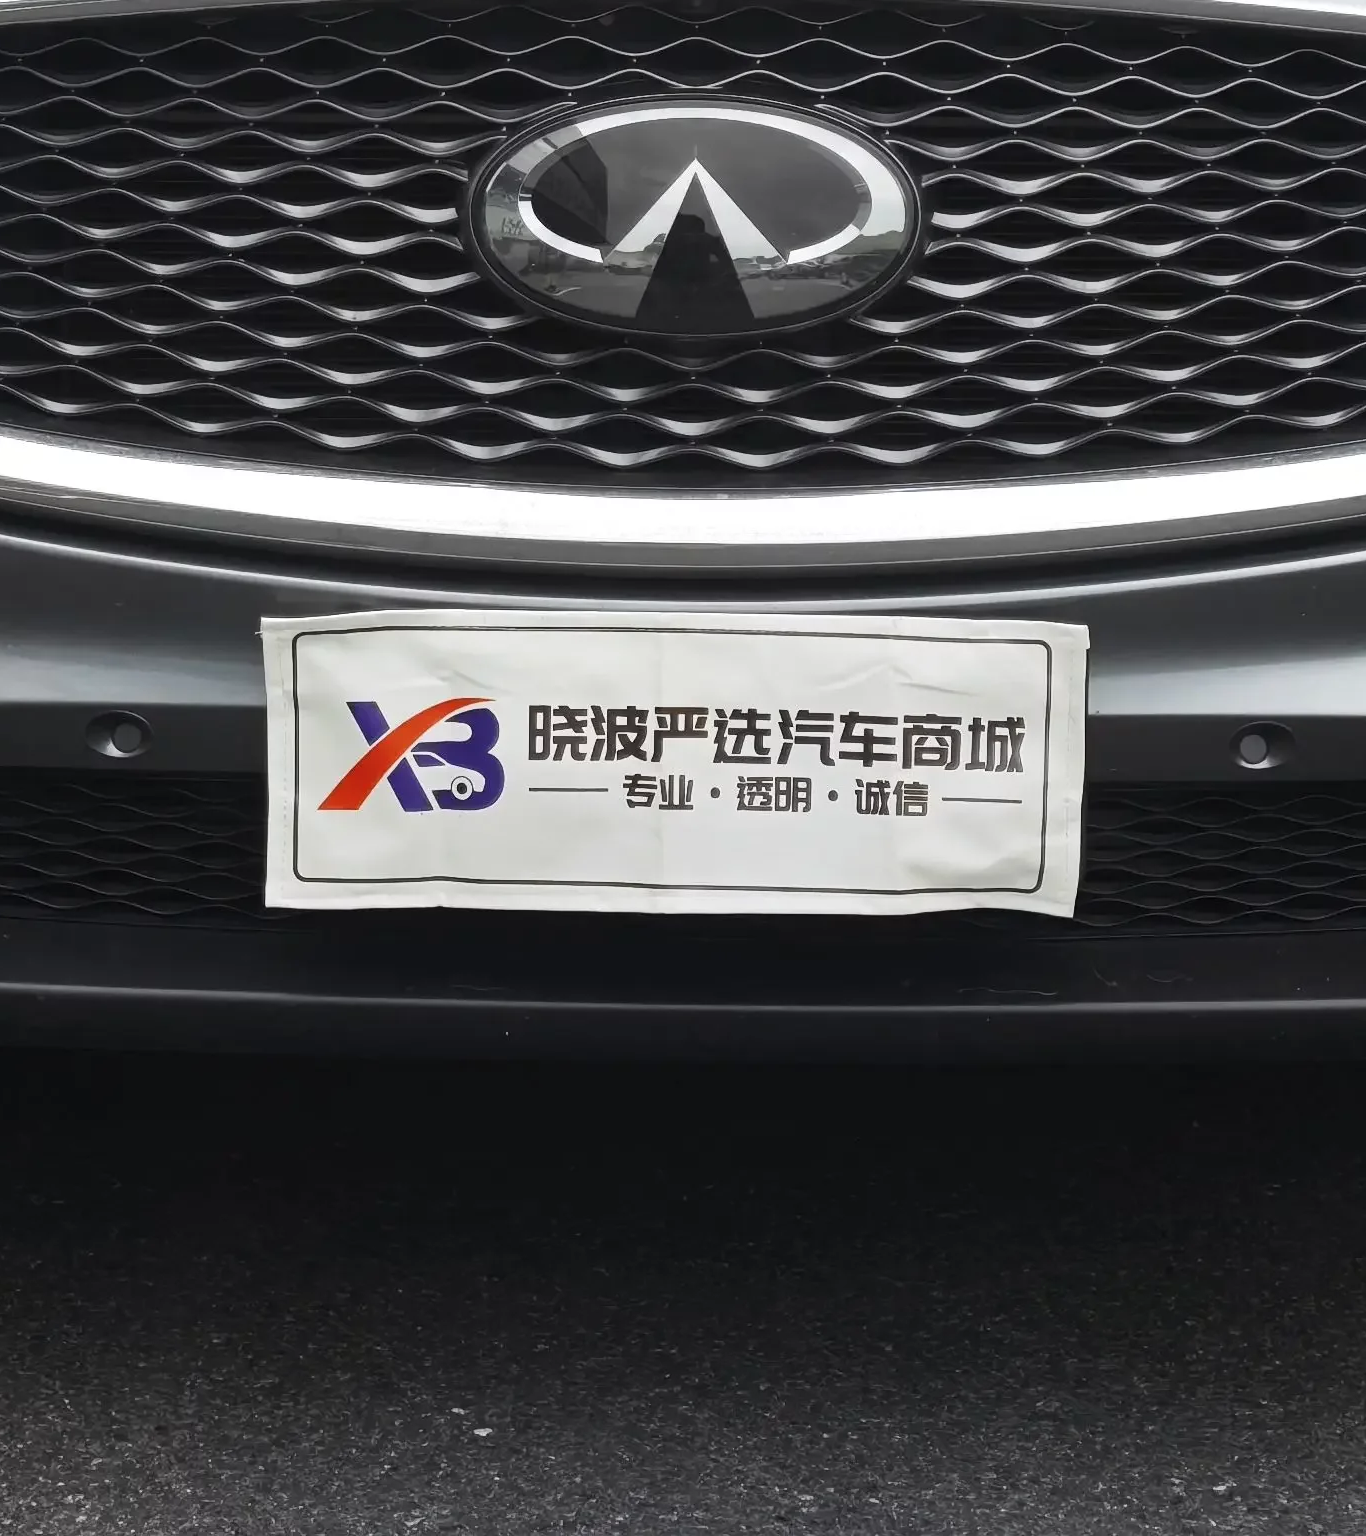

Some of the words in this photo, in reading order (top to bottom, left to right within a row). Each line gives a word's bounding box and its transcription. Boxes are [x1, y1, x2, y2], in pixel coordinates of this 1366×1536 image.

[527, 704, 1025, 774] 晓波严选汽车商城
